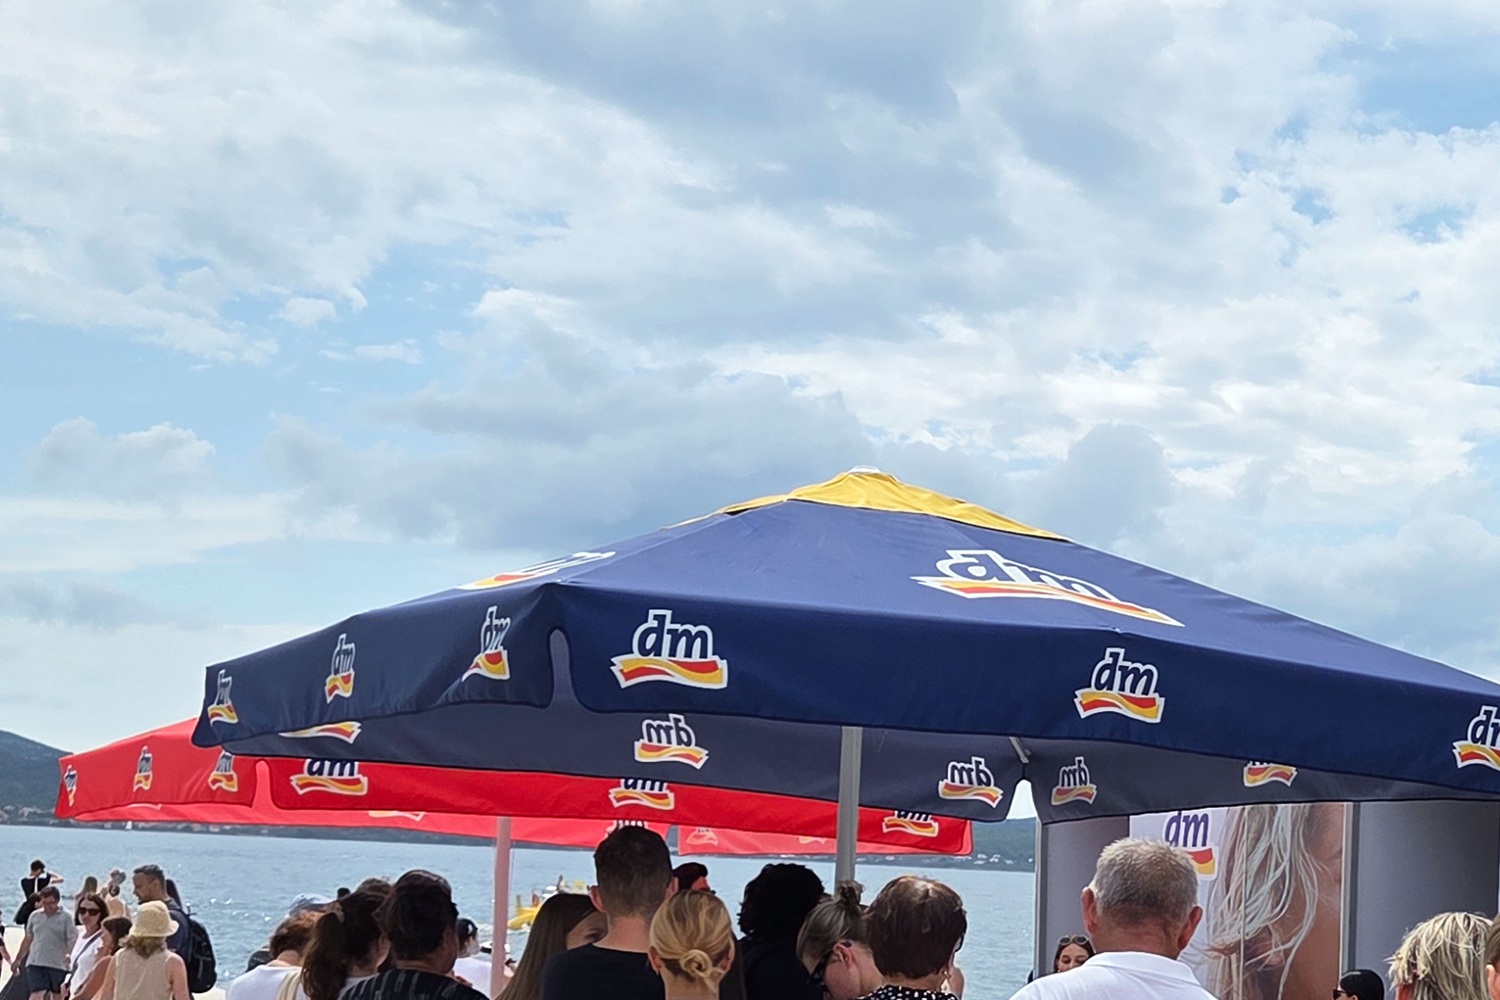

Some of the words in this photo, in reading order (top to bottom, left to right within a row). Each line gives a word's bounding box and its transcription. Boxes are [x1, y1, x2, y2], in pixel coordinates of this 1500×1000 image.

[637, 614, 709, 660] dm
[1094, 650, 1155, 696] dm
[1165, 811, 1209, 847] dm
